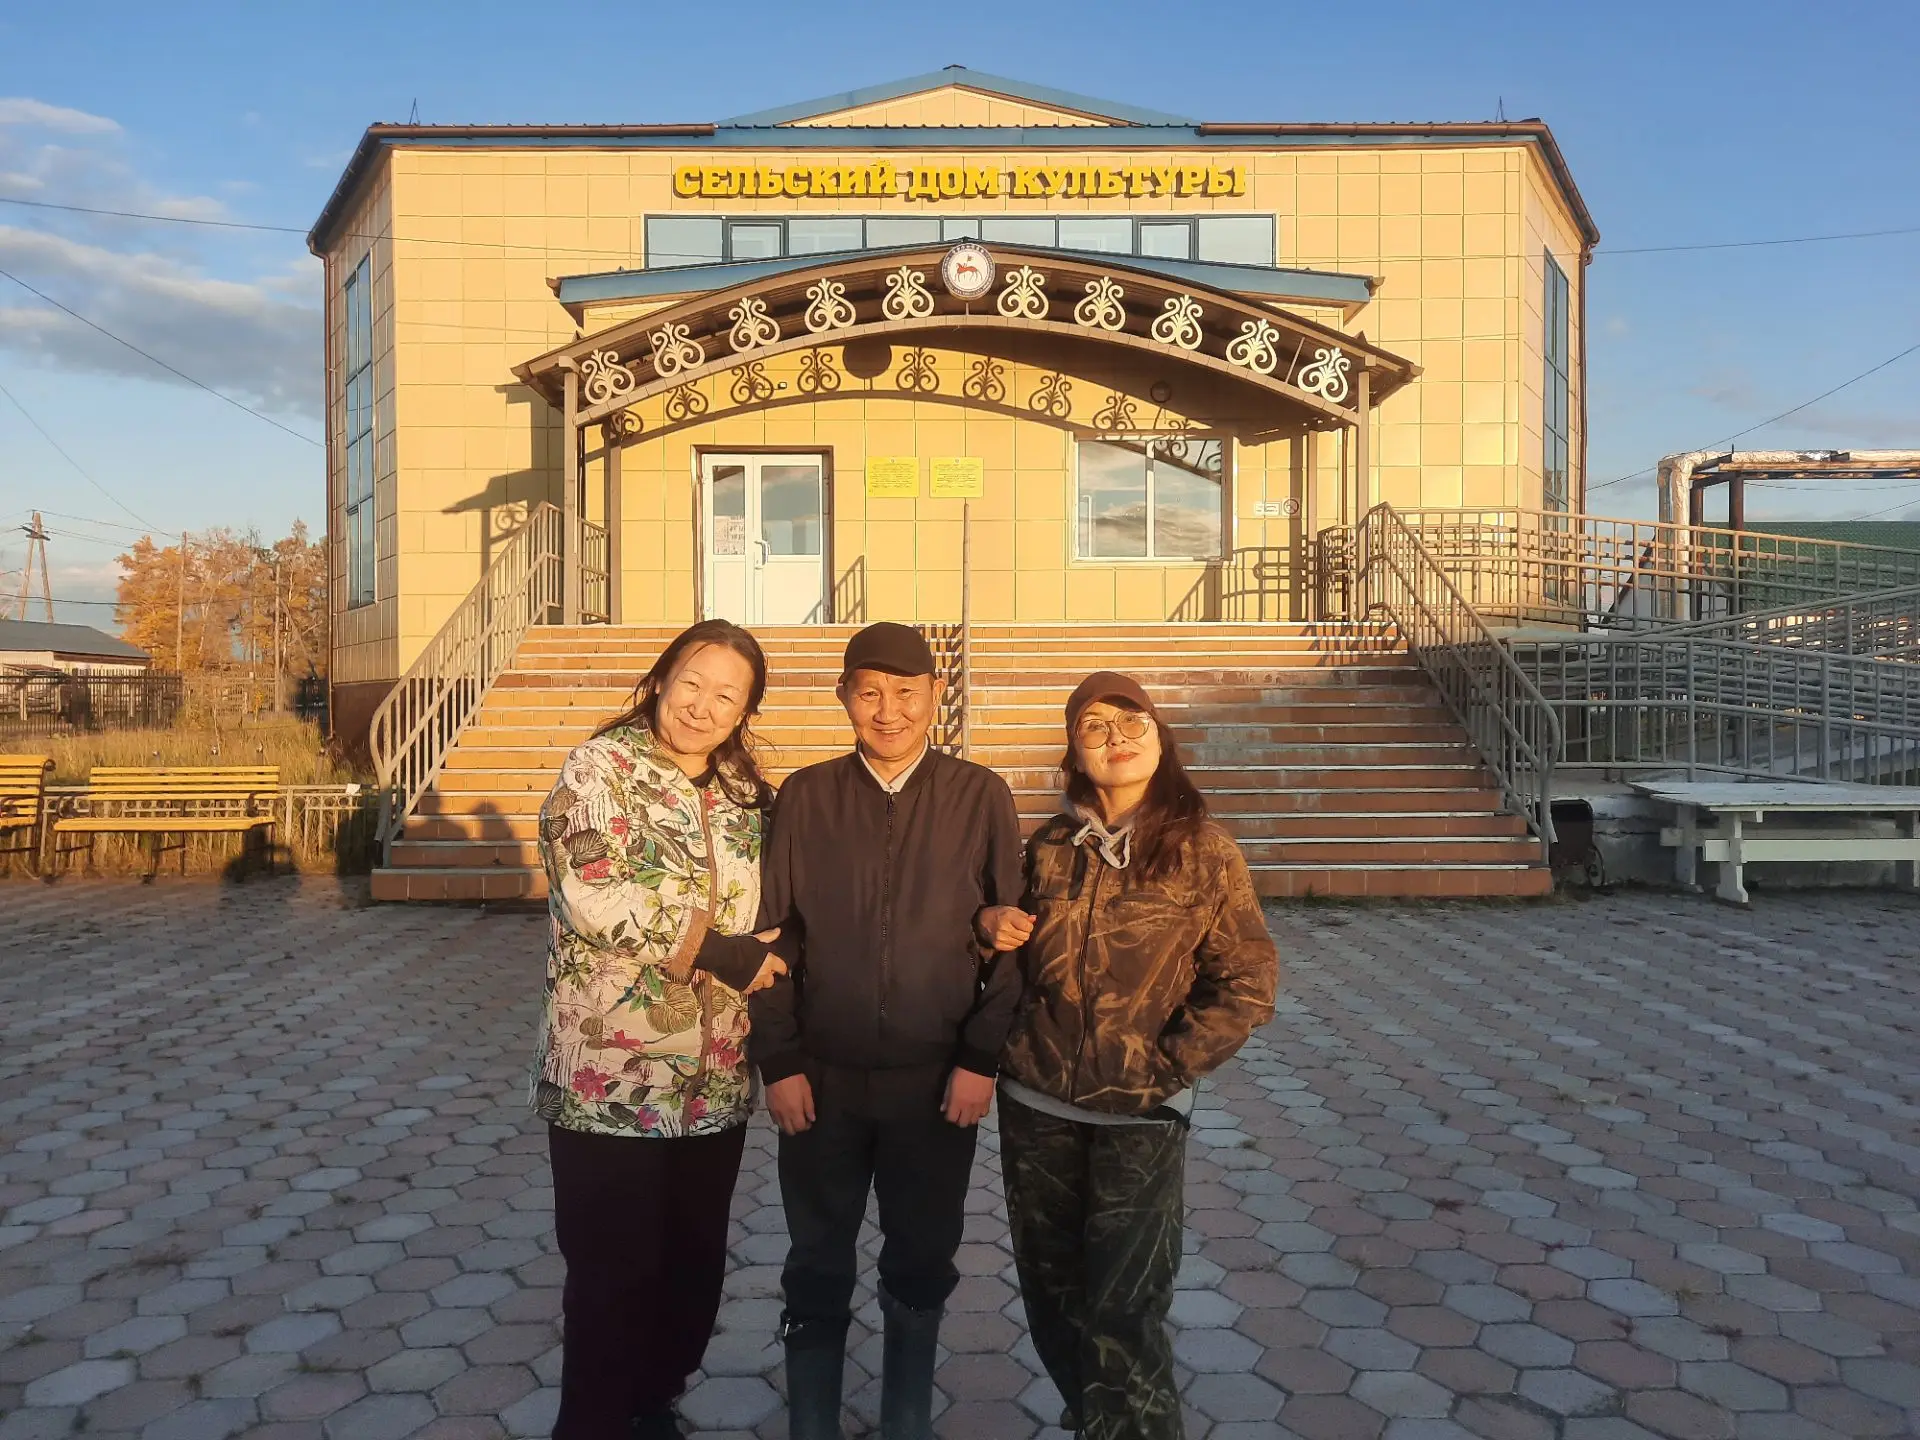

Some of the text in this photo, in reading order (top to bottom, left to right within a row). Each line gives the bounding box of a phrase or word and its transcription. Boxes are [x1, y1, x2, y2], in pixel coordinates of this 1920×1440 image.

[674, 160, 1246, 200] СЕЛЬСКИЙ ДОМ КУЛЬТУРЫ
